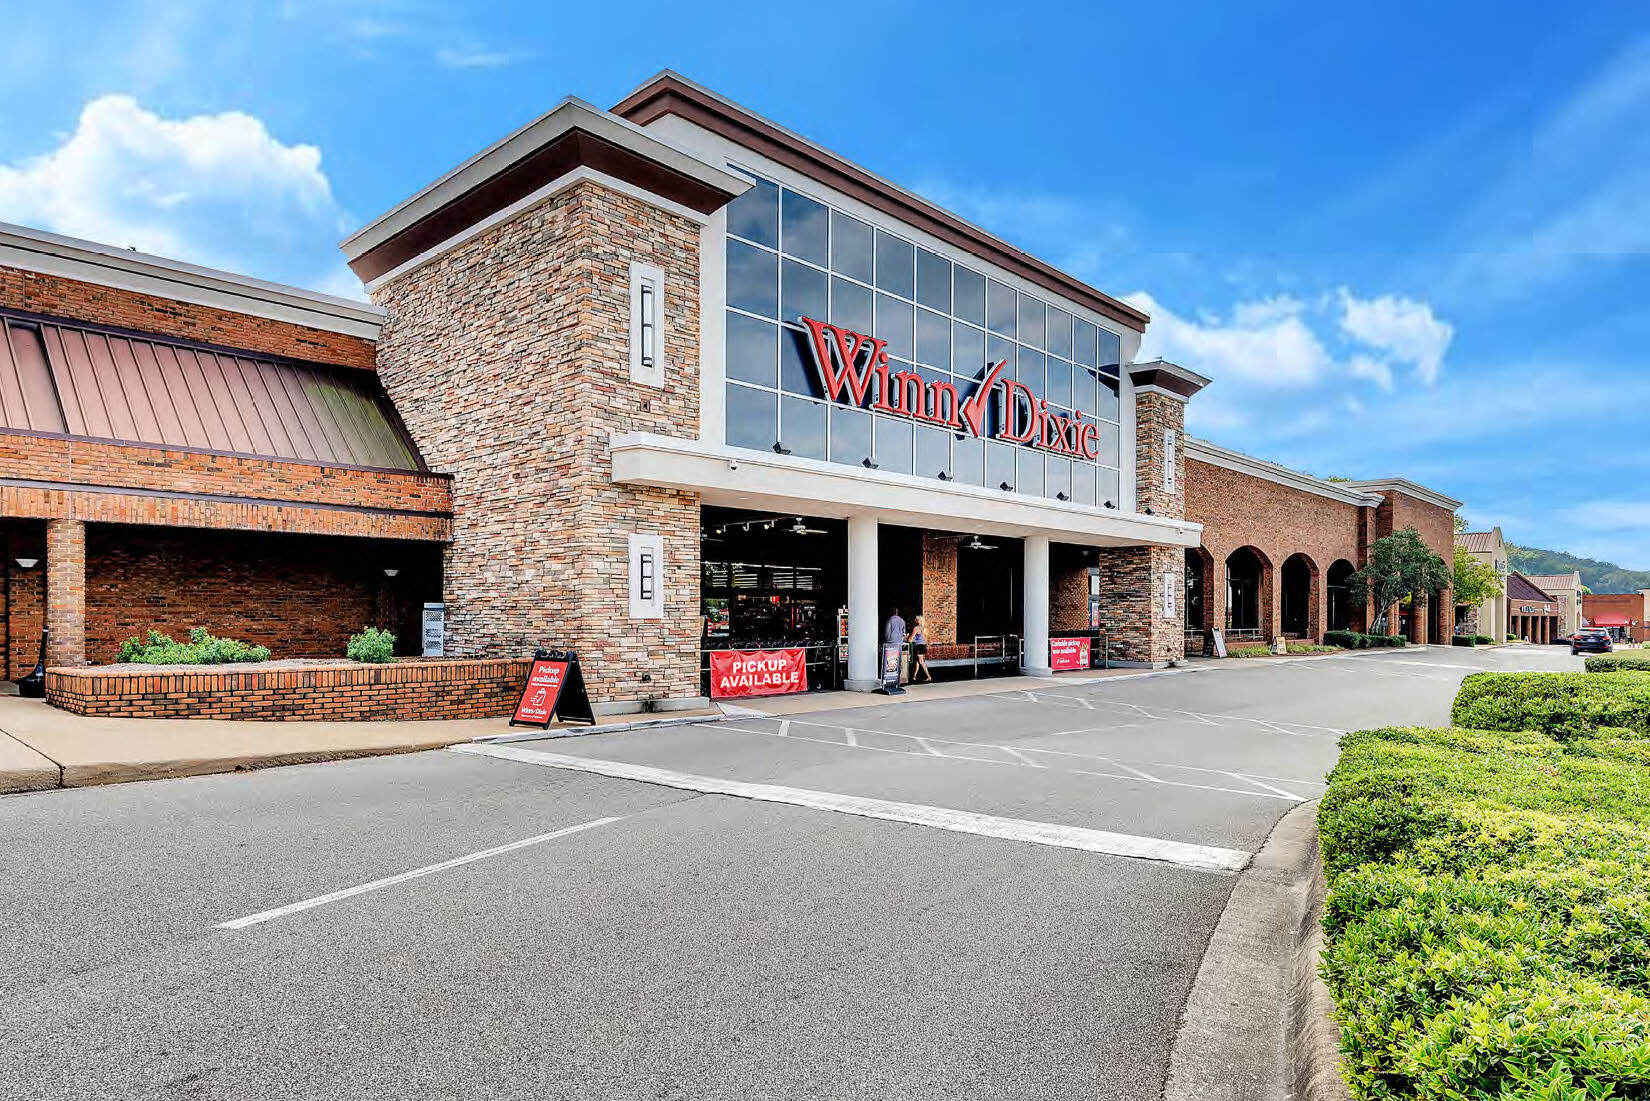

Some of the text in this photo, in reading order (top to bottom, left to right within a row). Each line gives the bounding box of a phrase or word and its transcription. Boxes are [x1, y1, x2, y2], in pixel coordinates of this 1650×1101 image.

[799, 316, 1099, 460] Winn Dixie
[539, 666, 559, 675] Pickup
[733, 659, 786, 673] PICKUP
[720, 672, 799, 688] AVAILABLE
